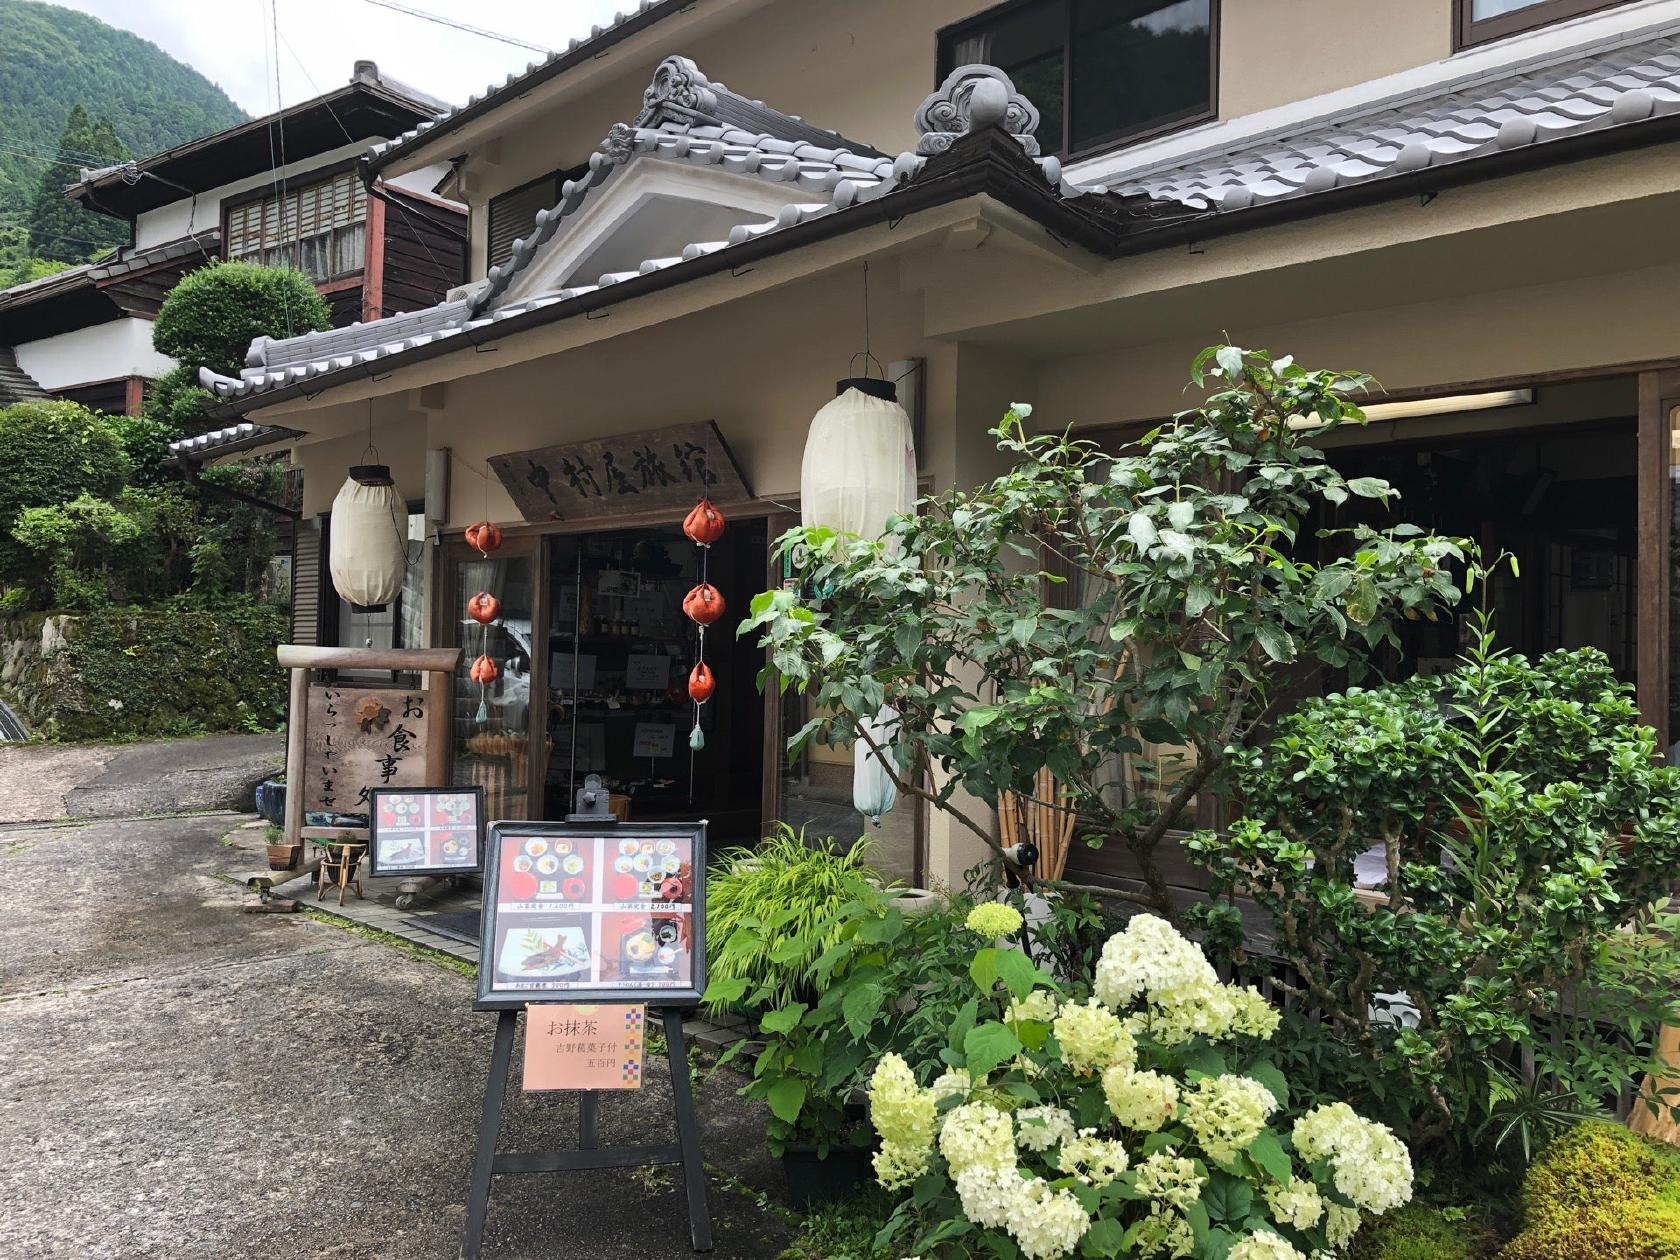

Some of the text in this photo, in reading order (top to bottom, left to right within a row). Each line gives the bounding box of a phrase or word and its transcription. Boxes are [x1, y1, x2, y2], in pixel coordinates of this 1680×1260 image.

[319, 690, 341, 808] いらっしゃいませ
[547, 1019, 598, 1036] お抹茶
[584, 1058, 616, 1068] 五百円
